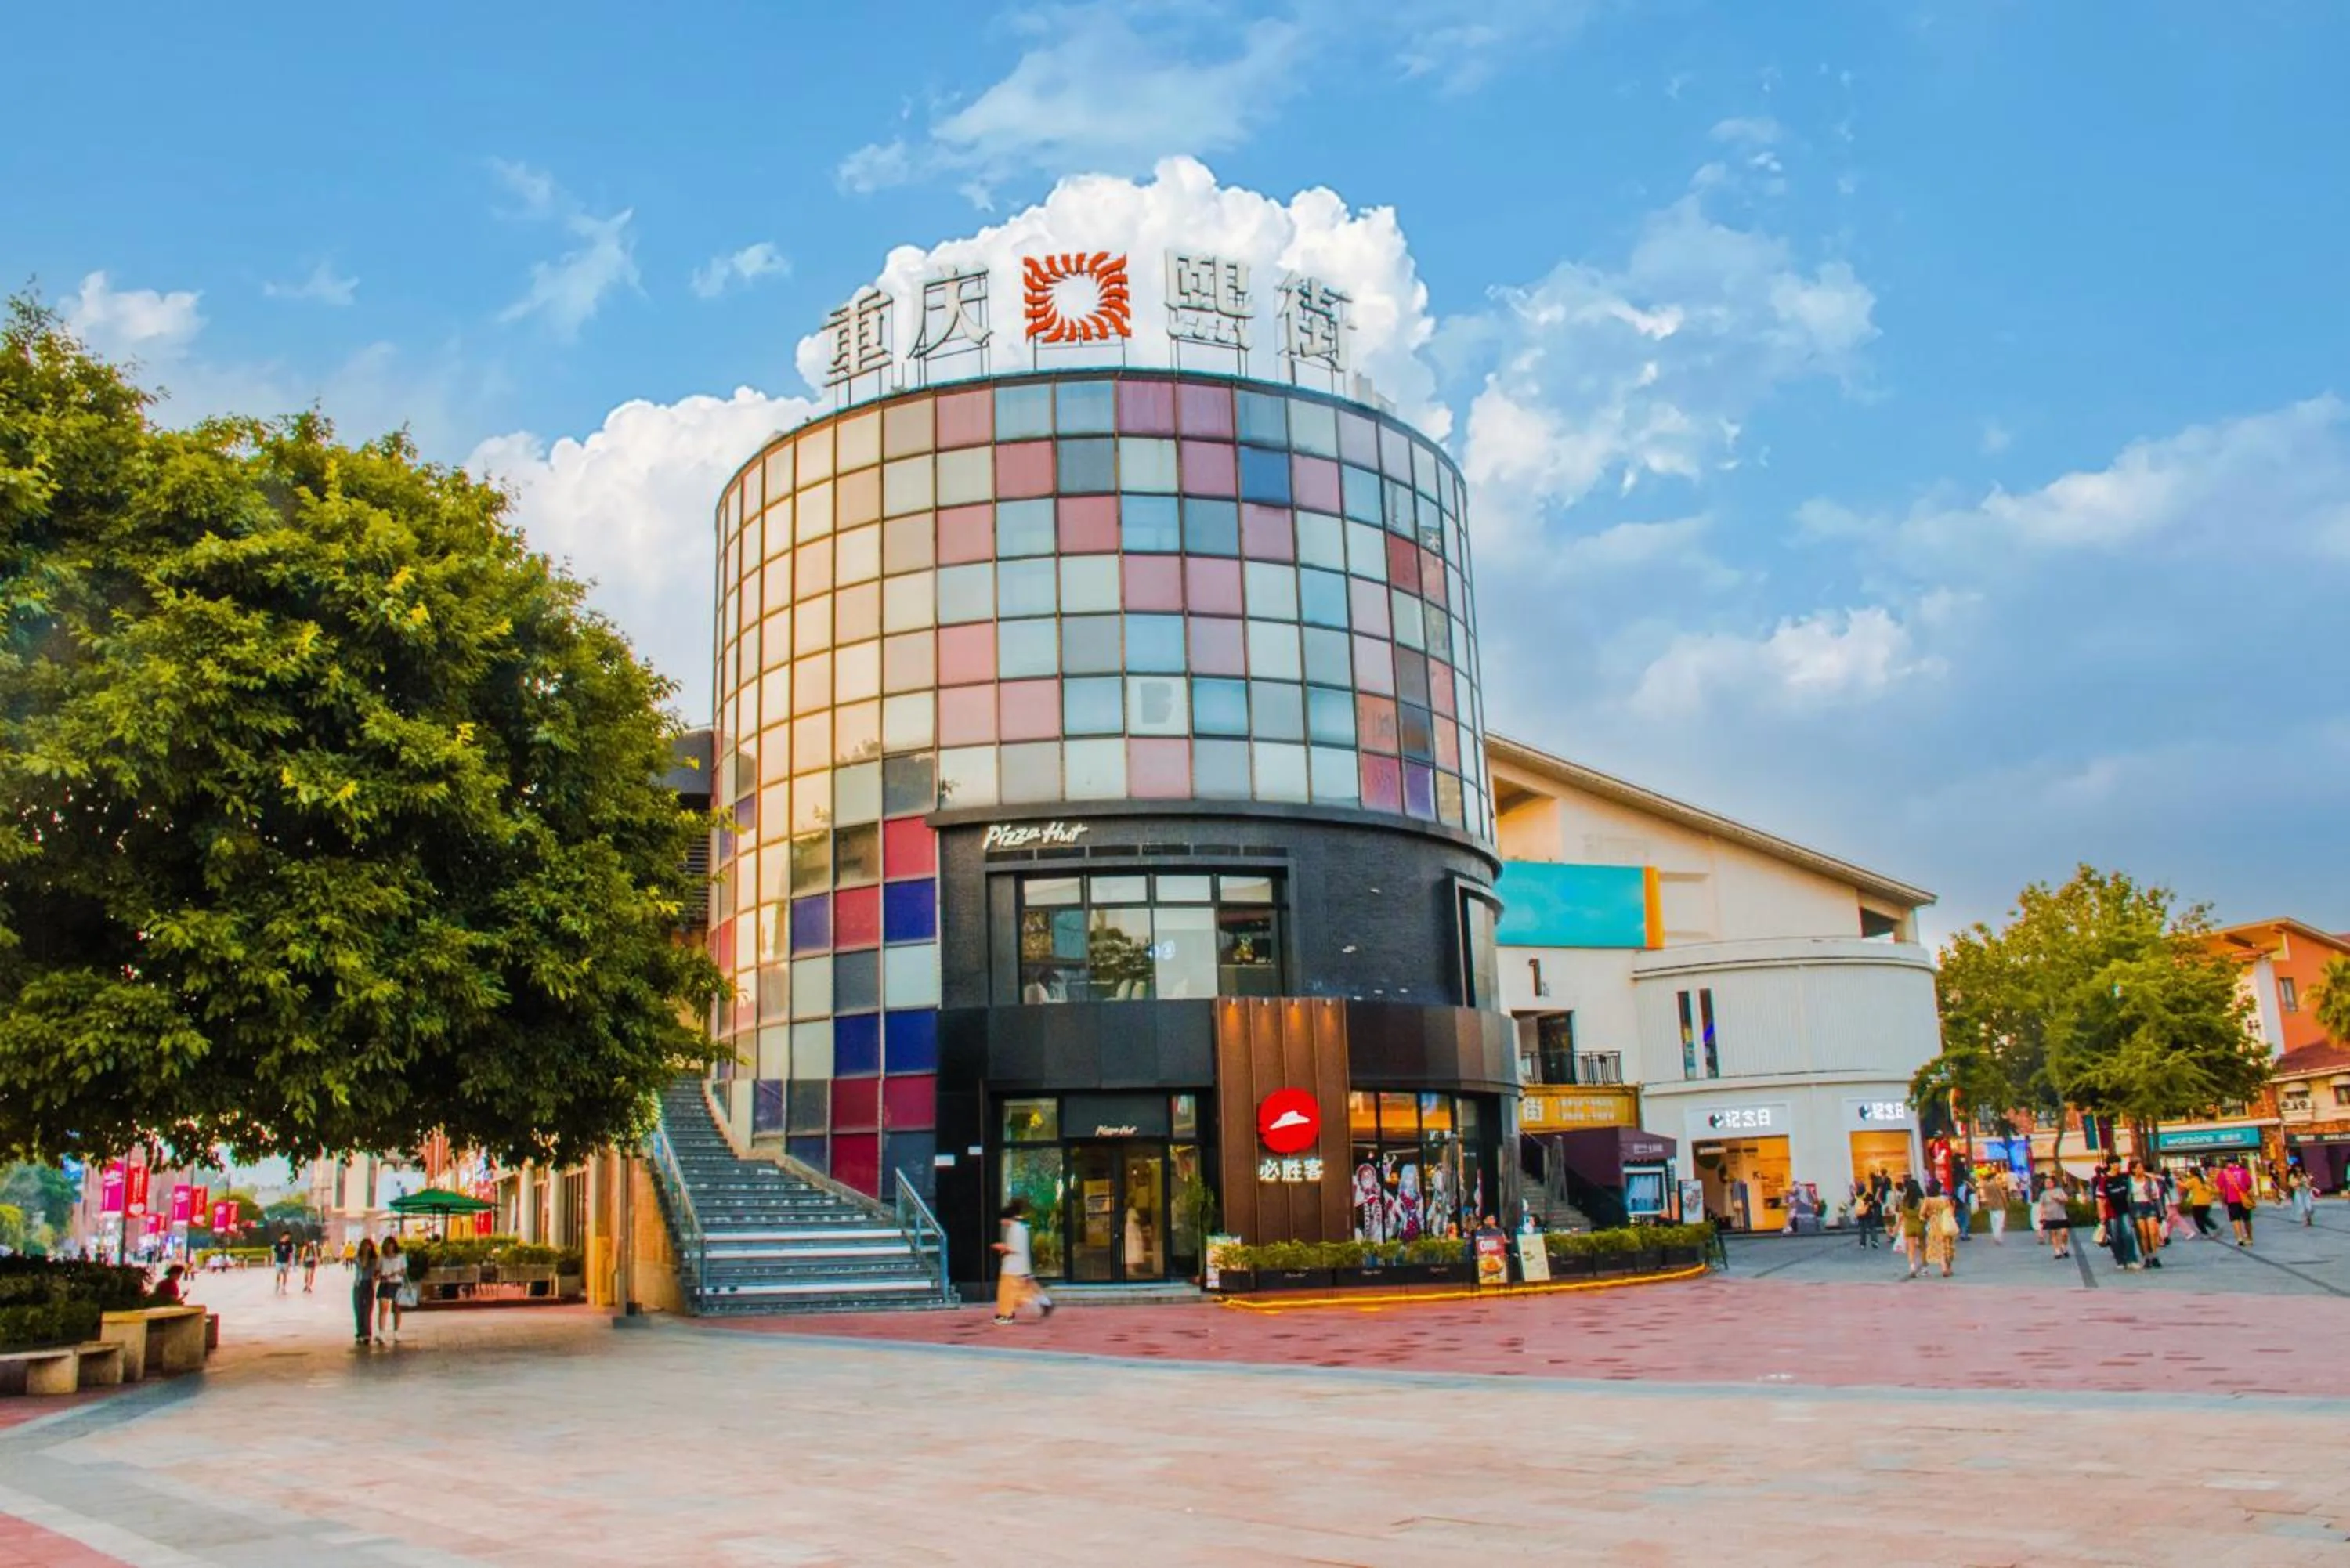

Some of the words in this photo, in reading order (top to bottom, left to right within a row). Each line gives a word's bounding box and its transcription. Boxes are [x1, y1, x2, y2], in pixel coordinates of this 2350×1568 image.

[820, 265, 993, 388] 重庆
[982, 824, 1040, 850] Pizza
[1041, 822, 1088, 844] Hut
[1725, 1107, 1770, 1129] 纪念日
[1259, 1158, 1324, 1183] 必胜客
